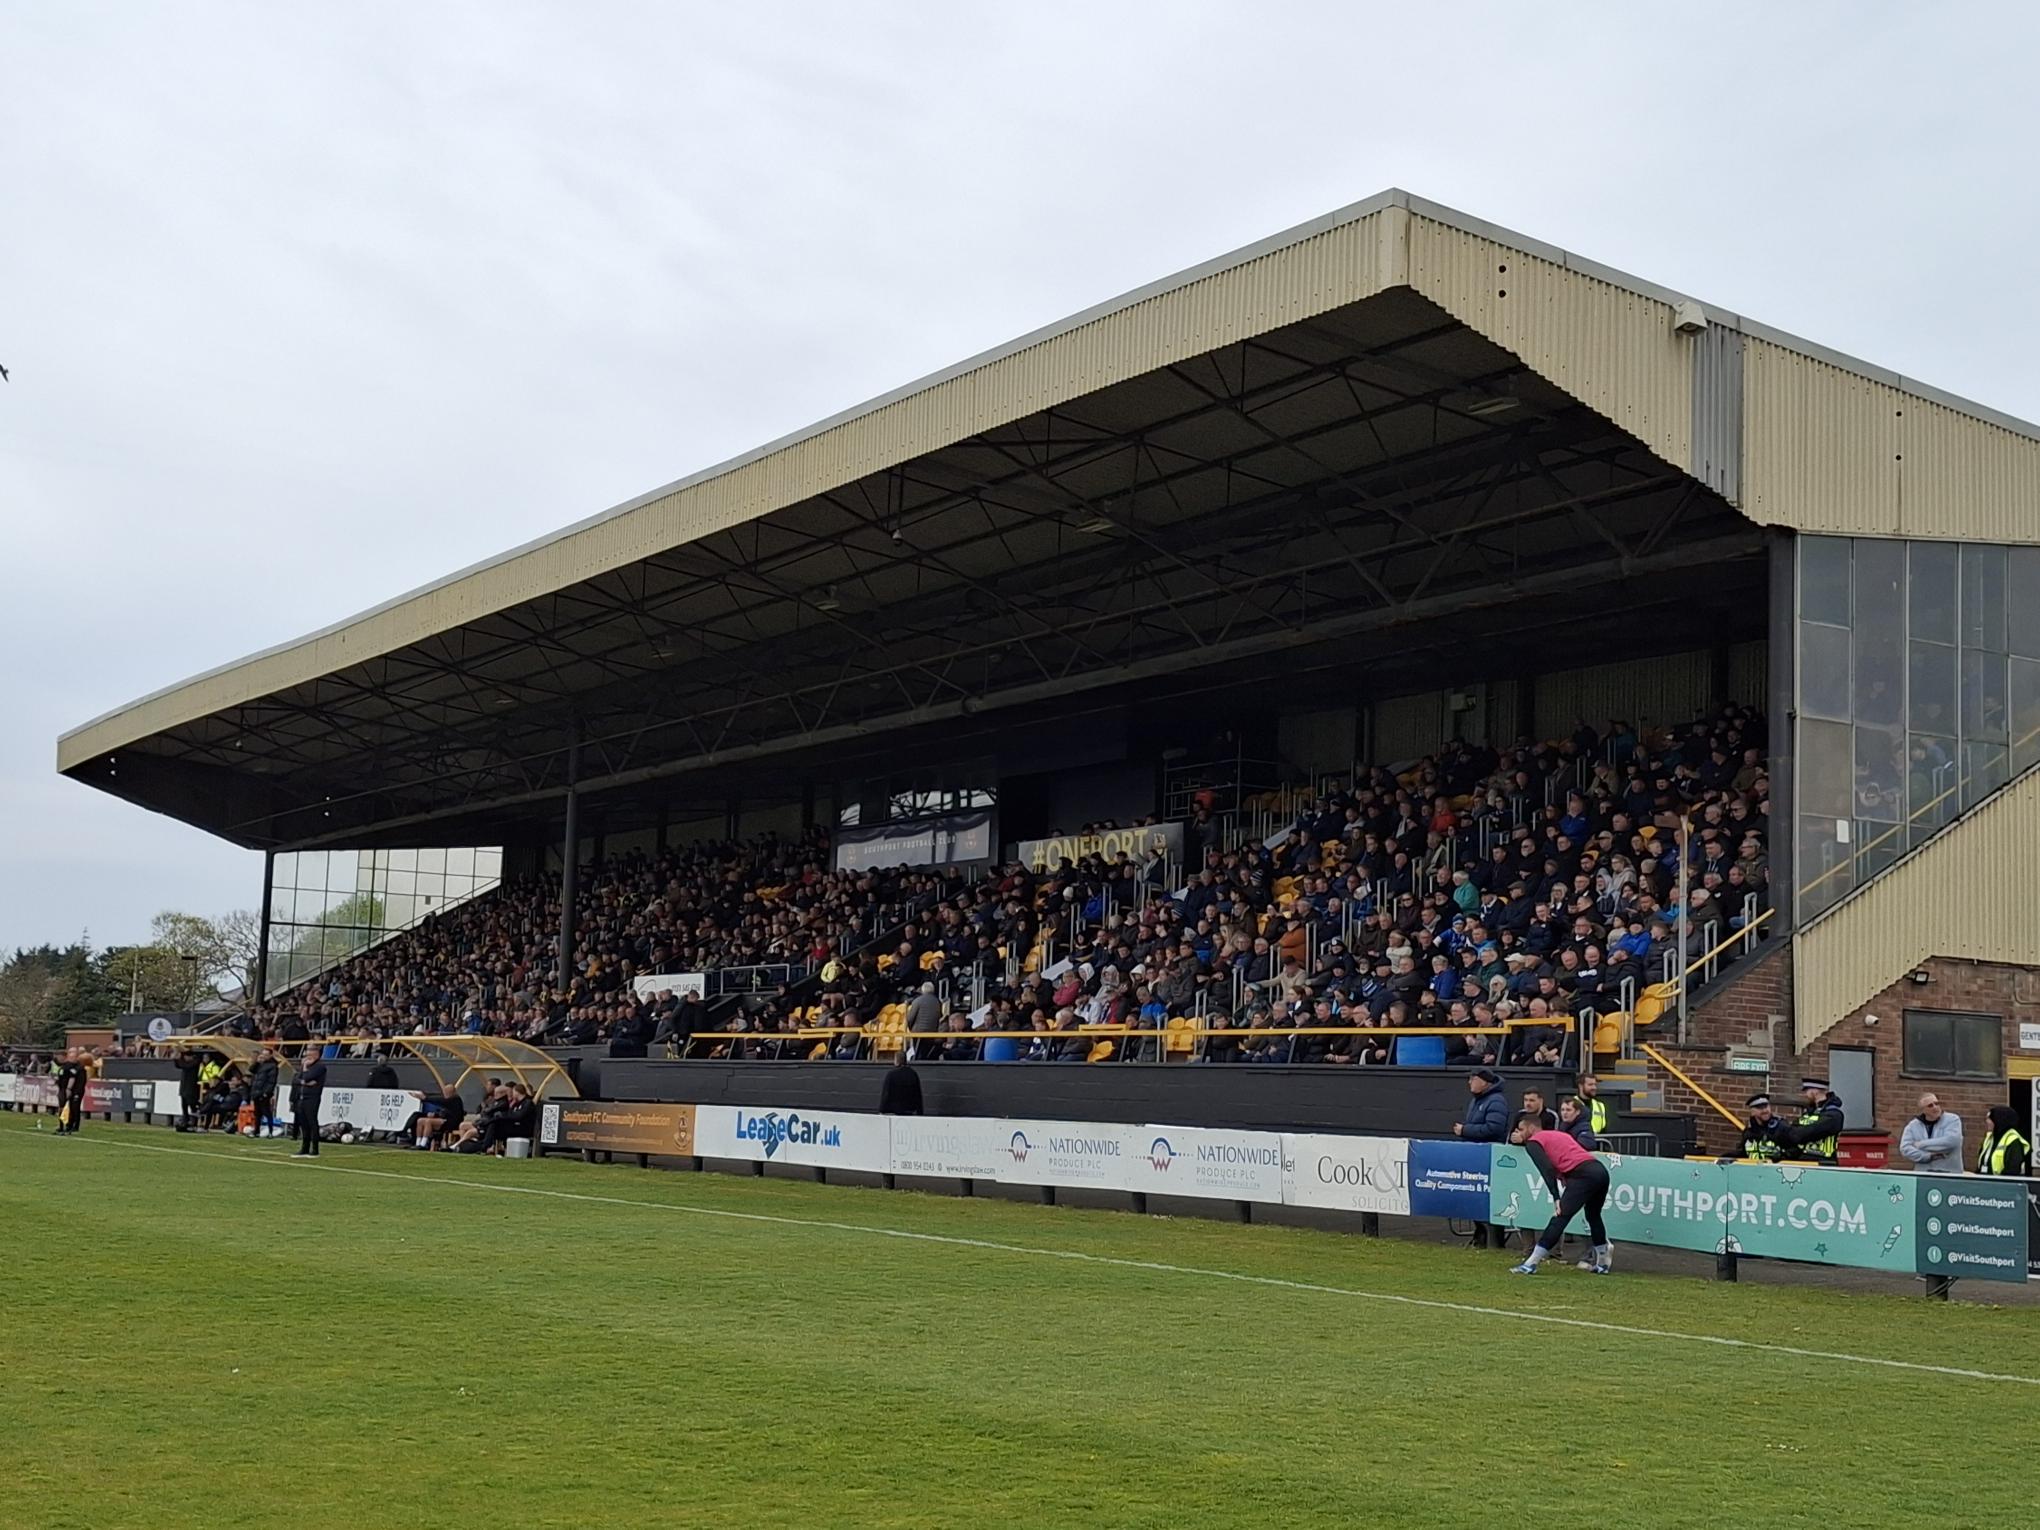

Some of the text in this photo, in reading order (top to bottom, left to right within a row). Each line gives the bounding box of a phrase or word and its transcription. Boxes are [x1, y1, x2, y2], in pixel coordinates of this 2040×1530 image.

[332, 1092, 354, 1105] BIG HELP
[380, 1094, 404, 1107] BIG HELP
[593, 1112, 601, 1123] FC
[1049, 1138, 1121, 1156] NATIONWIDE
[1197, 1144, 1280, 1166] NATIONWIDE
[1049, 1157, 1101, 1169] PRODUCE PLC
[1196, 1166, 1256, 1180] PRODUCE PLC
[1462, 1170, 1488, 1183] Steering
[1415, 1178, 1436, 1191] Quality
[1437, 1180, 1475, 1192] Components
[1525, 1173, 1867, 1235] VOUTHPORT.COM
[1948, 1194, 2015, 1209] @VisitSouthport
[1947, 1222, 2015, 1238] @VisitSouthport
[1947, 1251, 2015, 1268] @VisitSouthport
